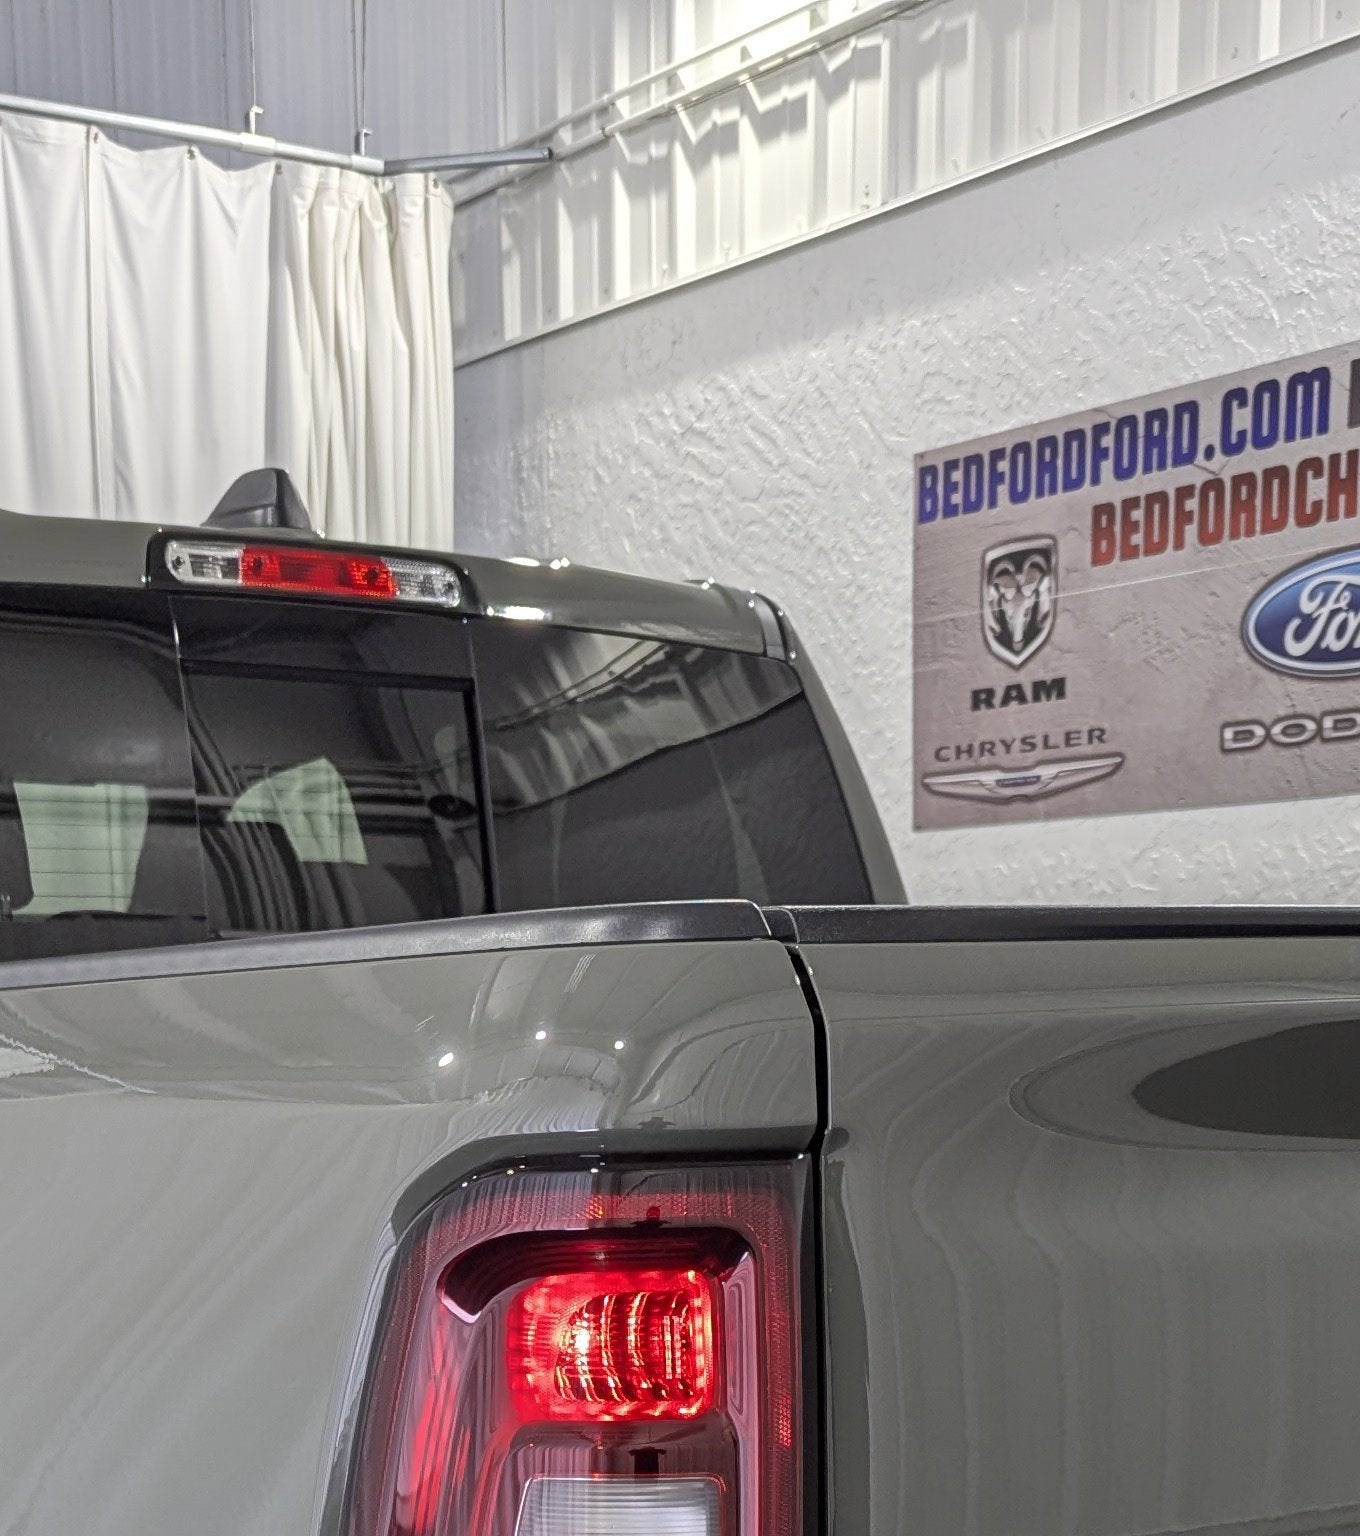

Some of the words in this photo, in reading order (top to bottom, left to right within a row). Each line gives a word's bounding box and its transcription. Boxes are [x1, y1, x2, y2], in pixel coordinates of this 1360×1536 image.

[917, 366, 1331, 524] BEDFORDFORD.COM
[970, 677, 1067, 712] RAM
[933, 727, 1107, 763] CHRYSLER
